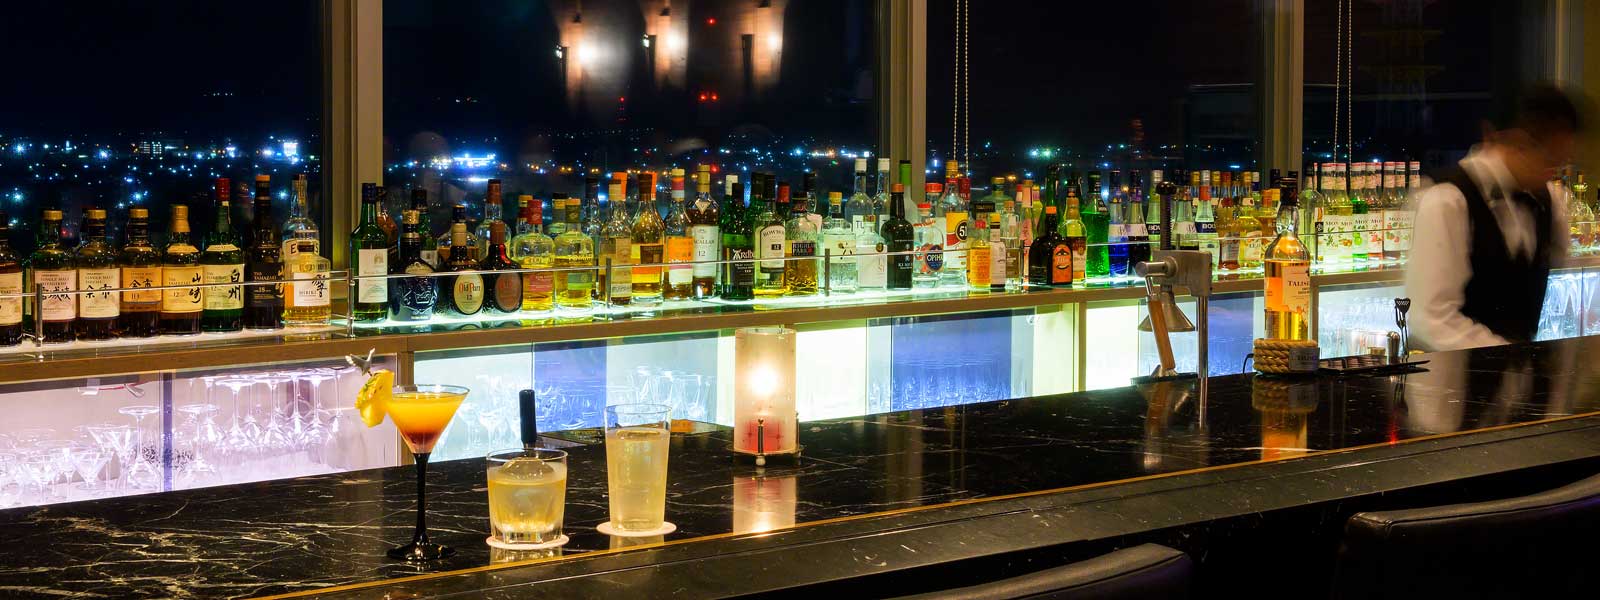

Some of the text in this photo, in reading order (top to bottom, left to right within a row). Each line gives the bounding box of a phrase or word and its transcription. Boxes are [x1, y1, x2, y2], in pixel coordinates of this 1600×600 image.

[960, 226, 968, 237] 51
[85, 283, 113, 299] 余市
[189, 272, 202, 303] 山崎
[228, 268, 241, 301] 白州
